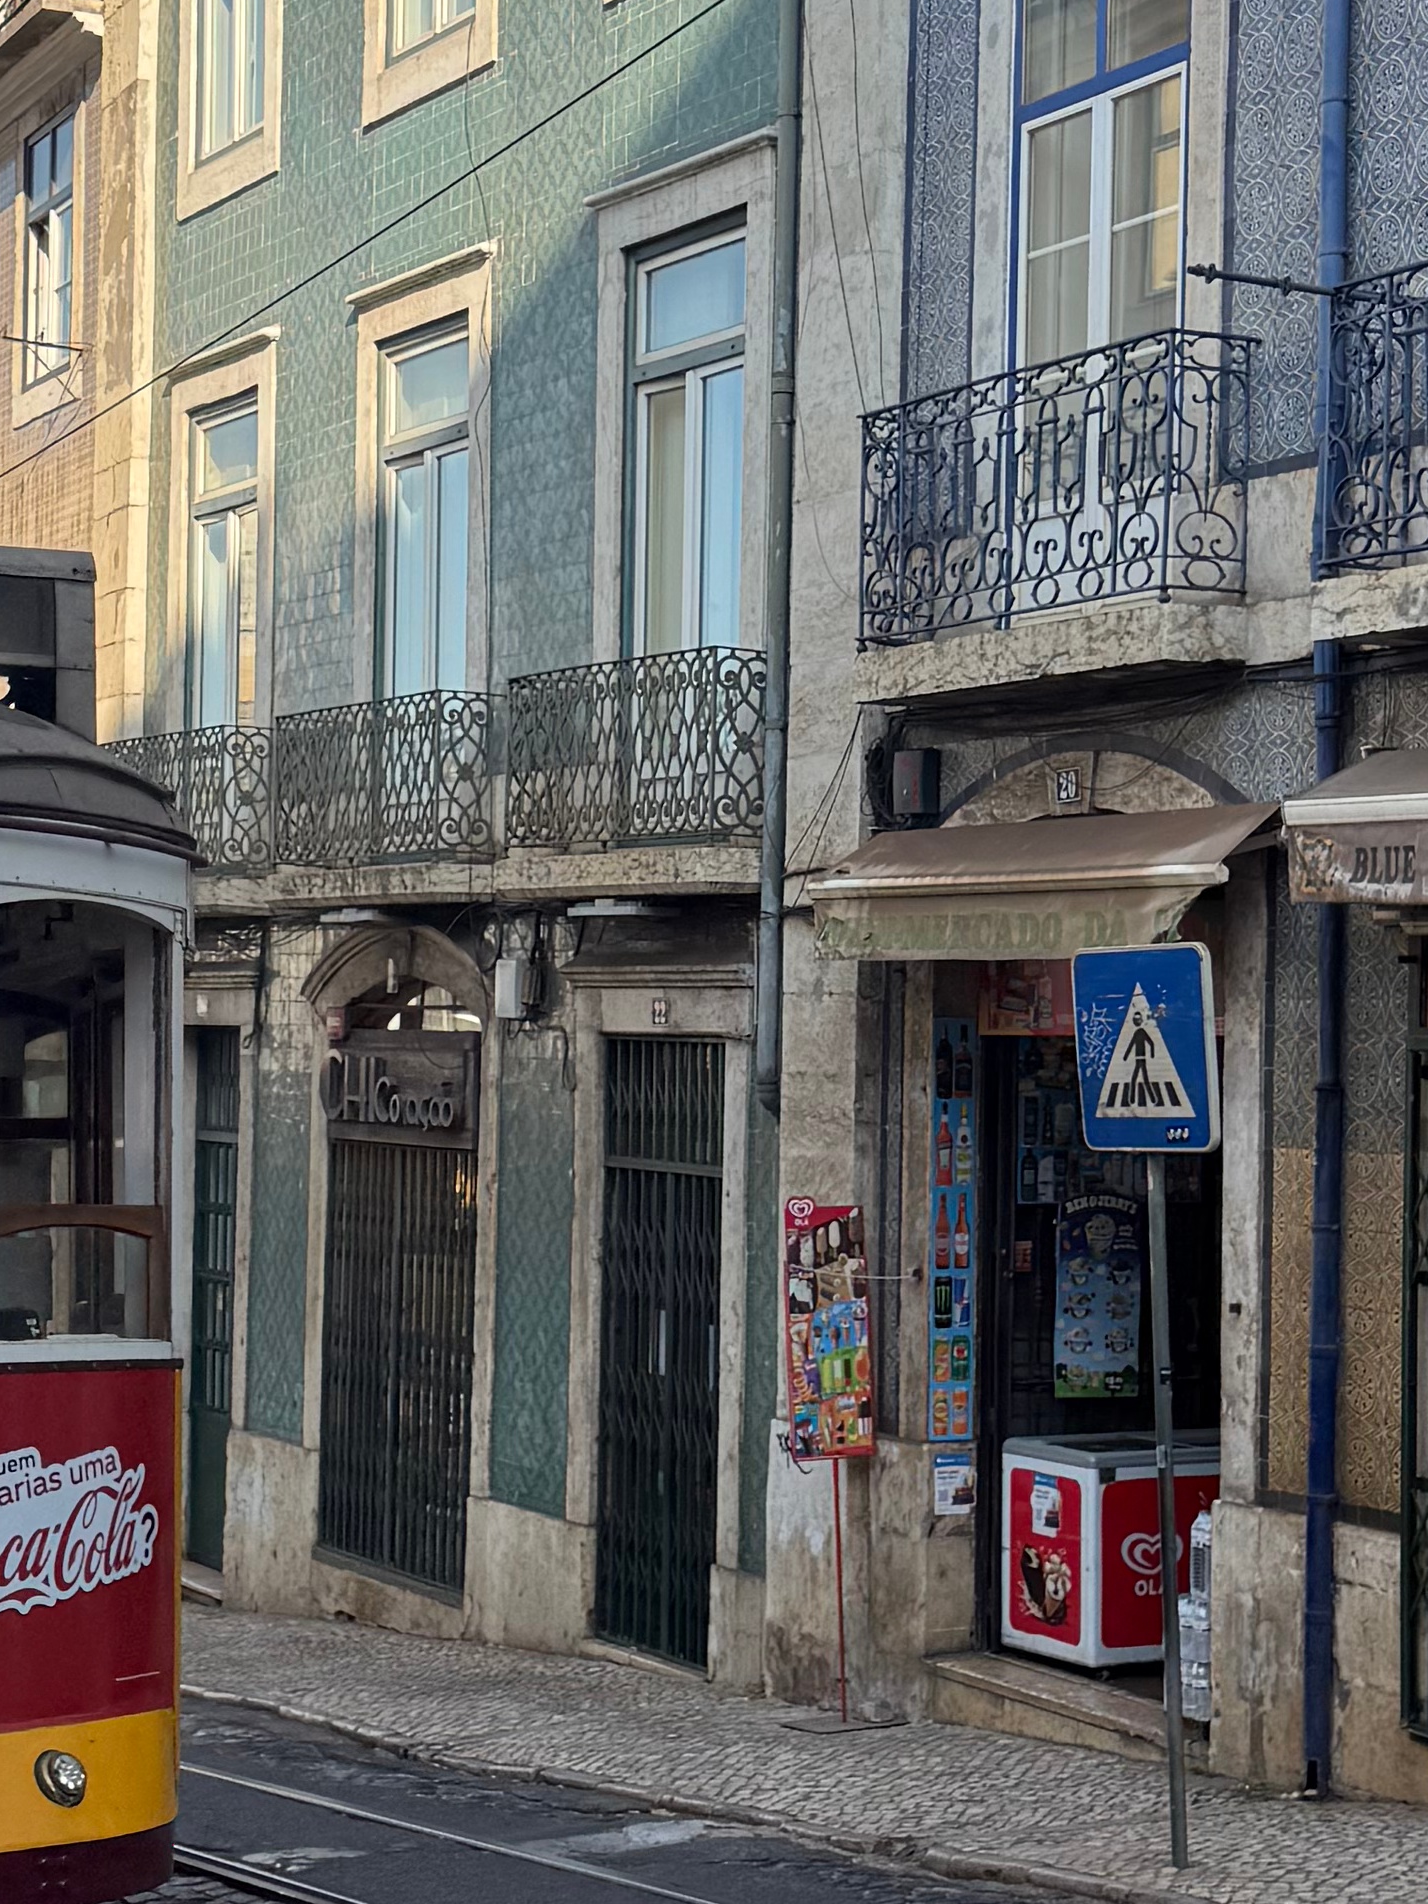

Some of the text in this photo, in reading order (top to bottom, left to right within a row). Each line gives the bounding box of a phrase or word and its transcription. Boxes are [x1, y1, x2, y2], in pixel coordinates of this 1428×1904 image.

[1059, 771, 1076, 799] 20
[1348, 845, 1417, 885] BLUE
[654, 1000, 666, 1024] 22
[69, 1452, 119, 1486] uma
